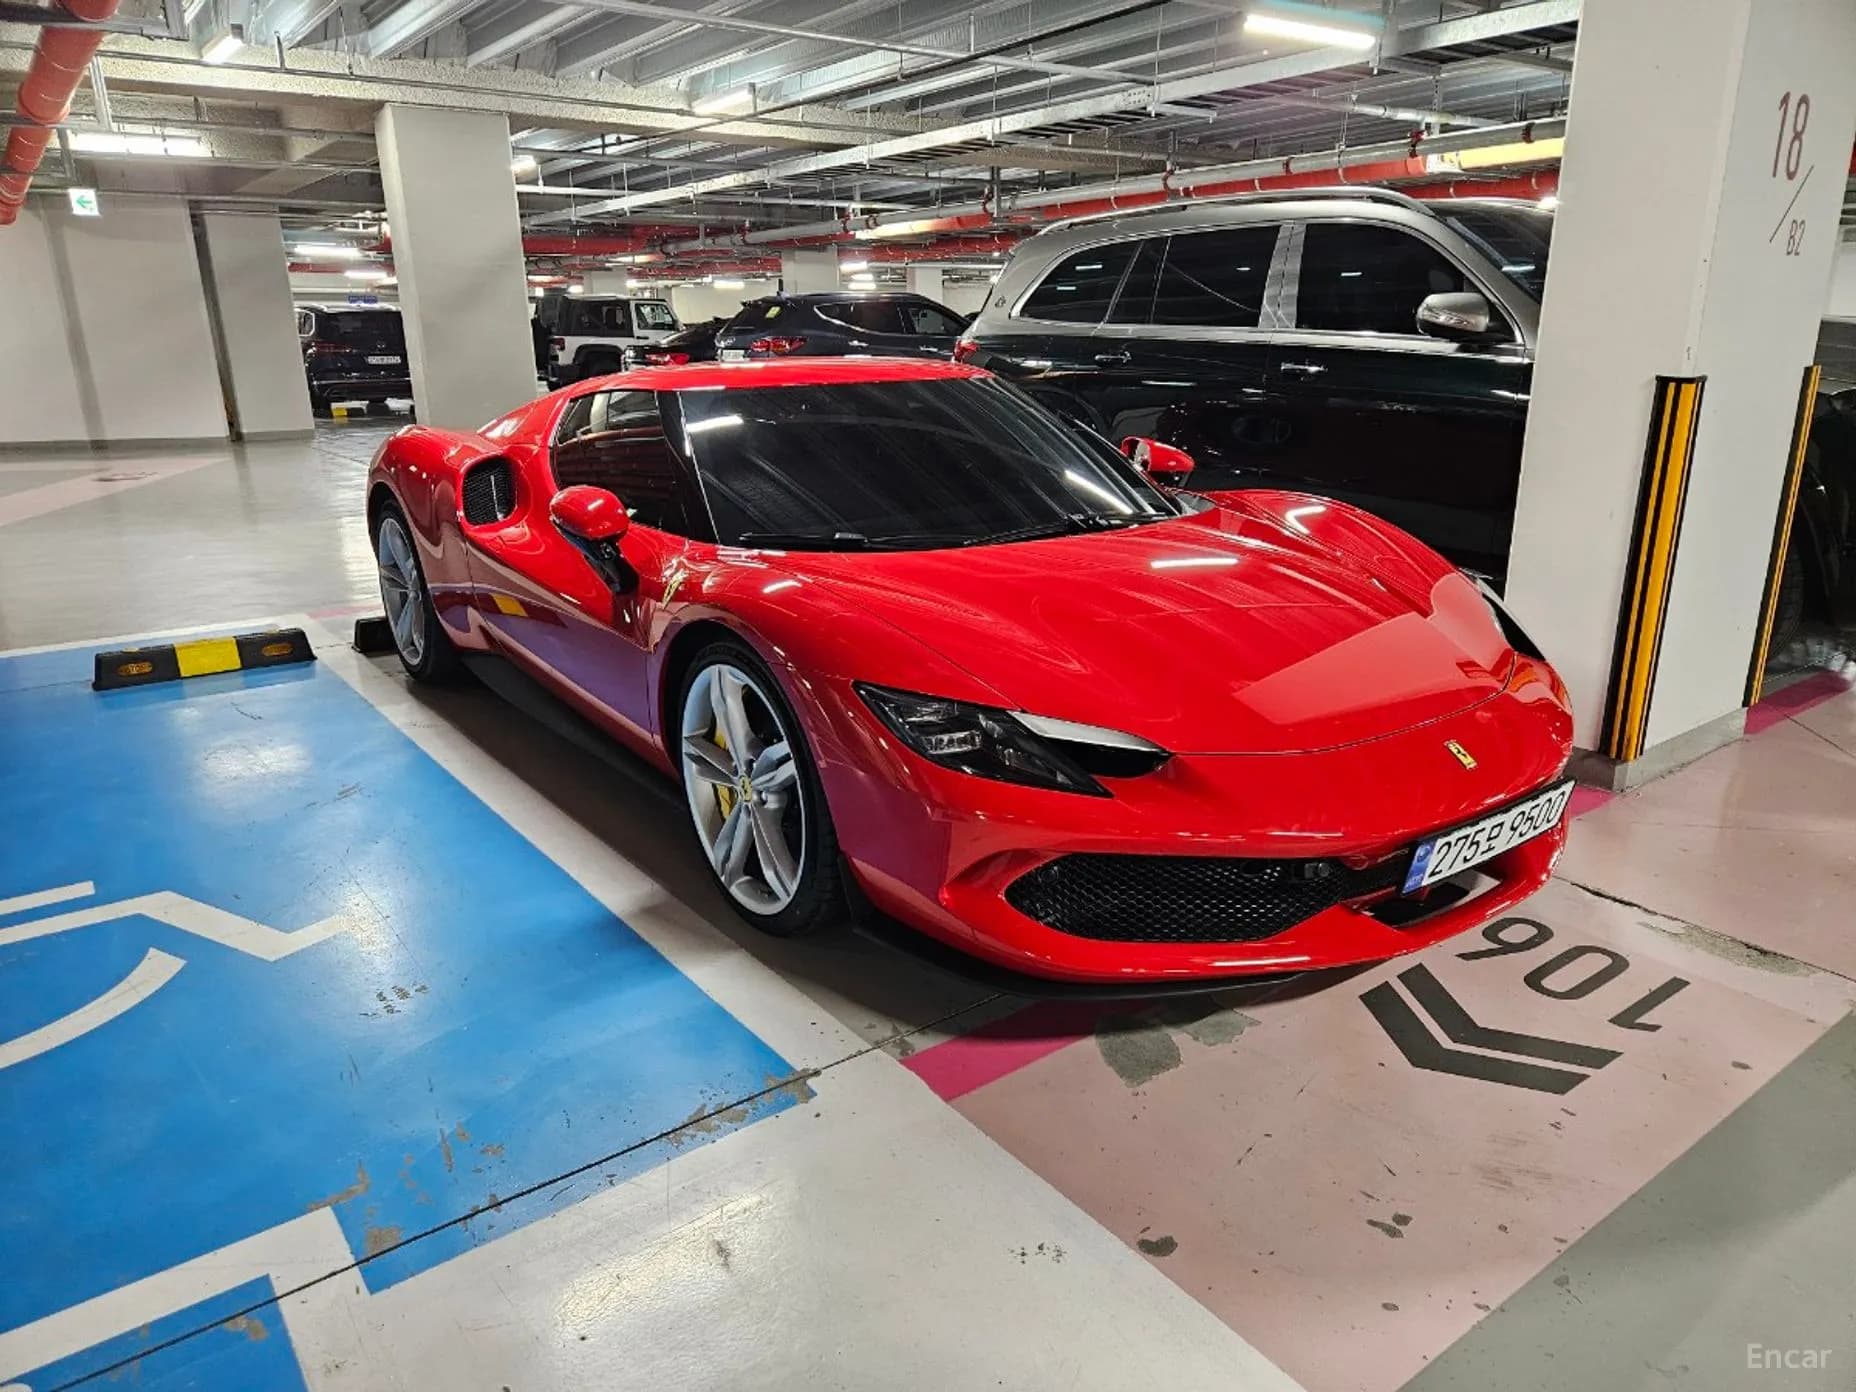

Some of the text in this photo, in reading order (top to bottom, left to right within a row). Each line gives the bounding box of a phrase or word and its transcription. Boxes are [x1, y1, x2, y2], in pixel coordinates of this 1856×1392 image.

[1772, 91, 1810, 181] 18
[1786, 219, 1806, 256] B2
[1428, 790, 1566, 878] 275모 9500
[1455, 917, 1691, 1032] 106
